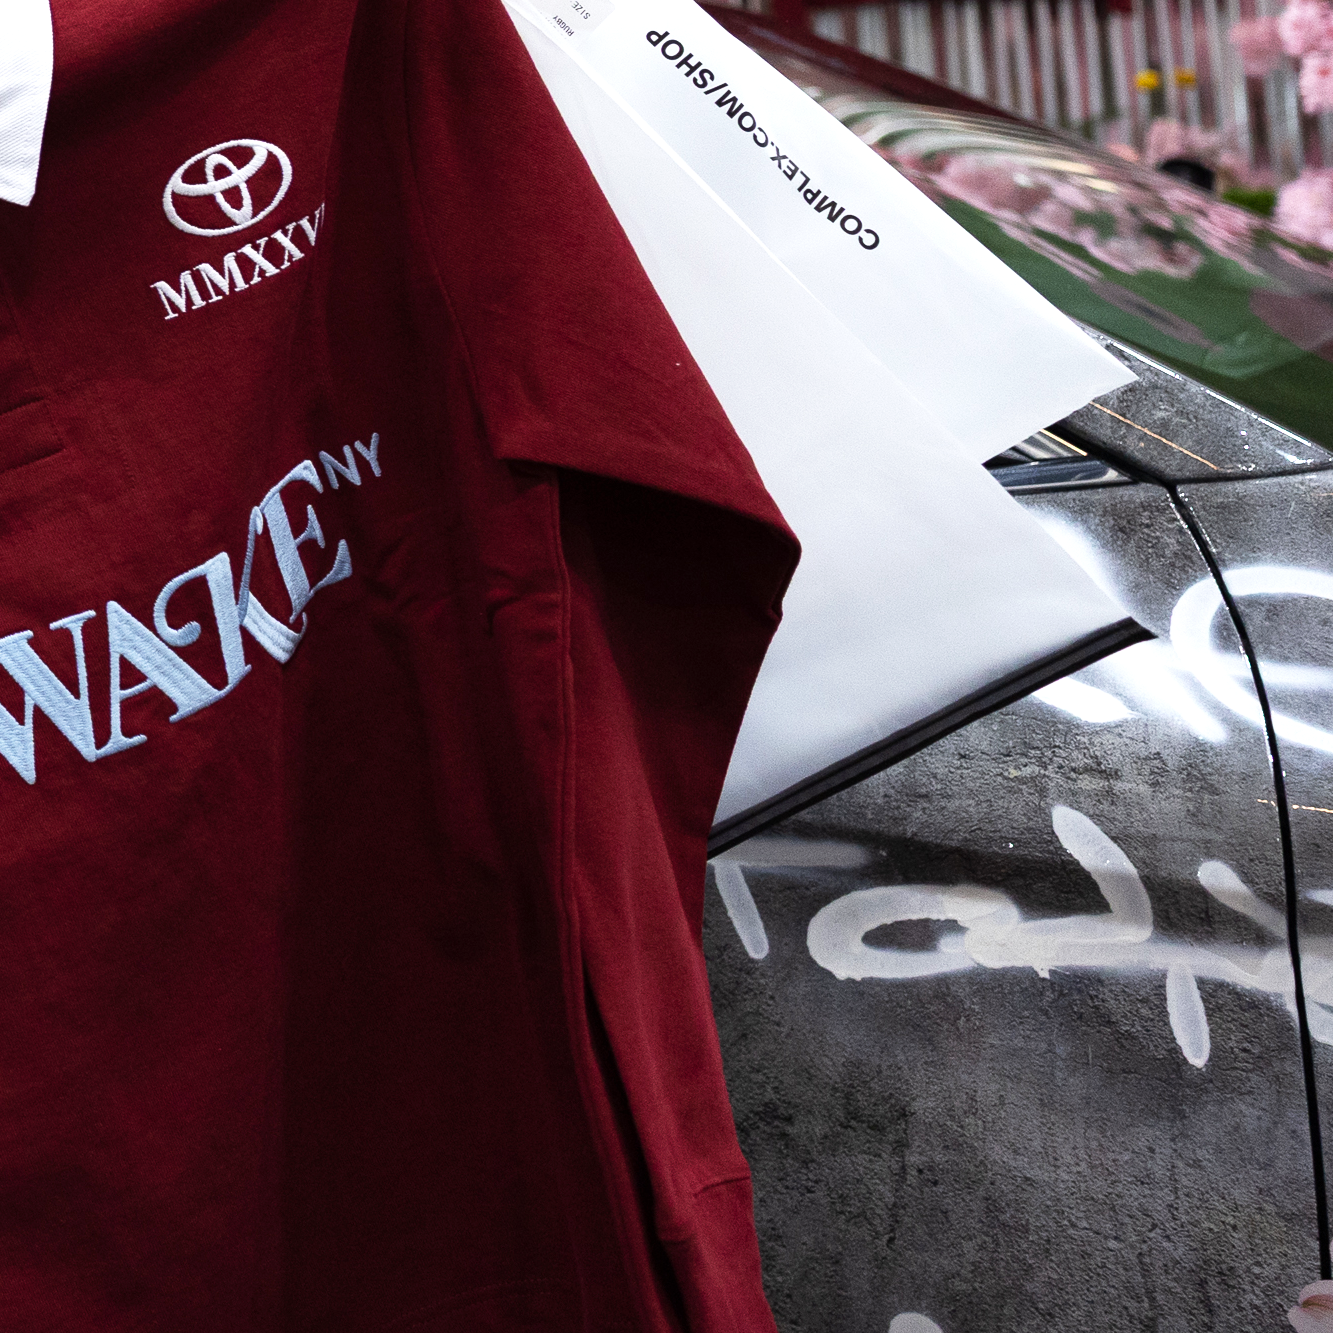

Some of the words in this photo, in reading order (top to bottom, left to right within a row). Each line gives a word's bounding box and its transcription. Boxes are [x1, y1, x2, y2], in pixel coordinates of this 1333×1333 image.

[552, 15, 575, 37] RUGBY
[645, 29, 880, 251] COMPLEX.COM/SHOP
[319, 432, 381, 489] NY
